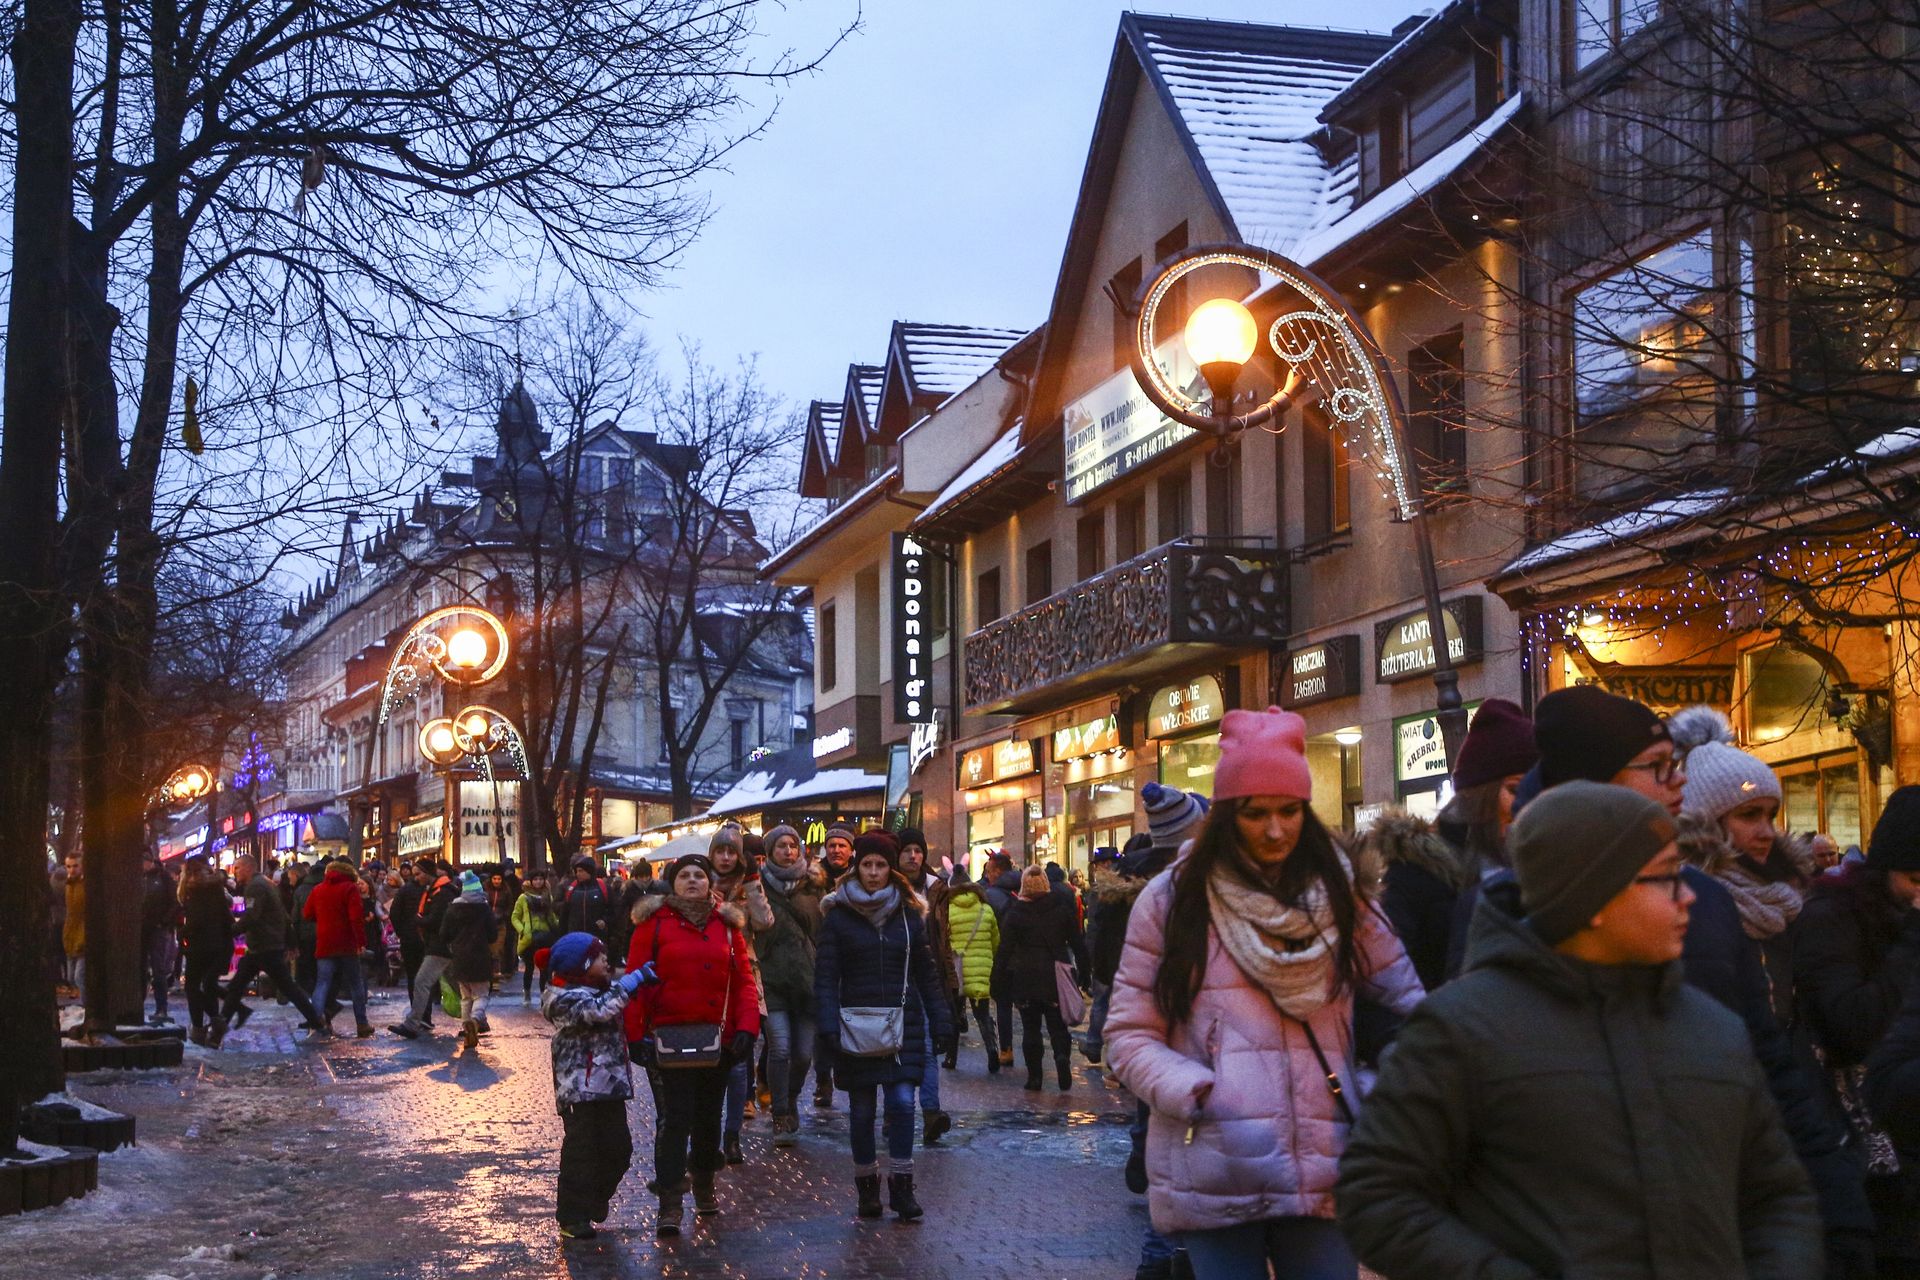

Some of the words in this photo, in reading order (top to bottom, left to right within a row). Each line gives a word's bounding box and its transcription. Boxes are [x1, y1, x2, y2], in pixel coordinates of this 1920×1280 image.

[902, 538, 926, 717] McDonald's
[1293, 650, 1326, 674] KARCZMA
[1381, 649, 1426, 677] BIŻUTERIA,
[1168, 684, 1200, 707] OBUWIE
[1293, 676, 1326, 699] ZAGRODA
[1160, 704, 1210, 731] WŁOSKIE
[1407, 740, 1437, 770] SREBRO
[1425, 758, 1447, 771] UPOMI
[462, 821, 518, 837] JADO
